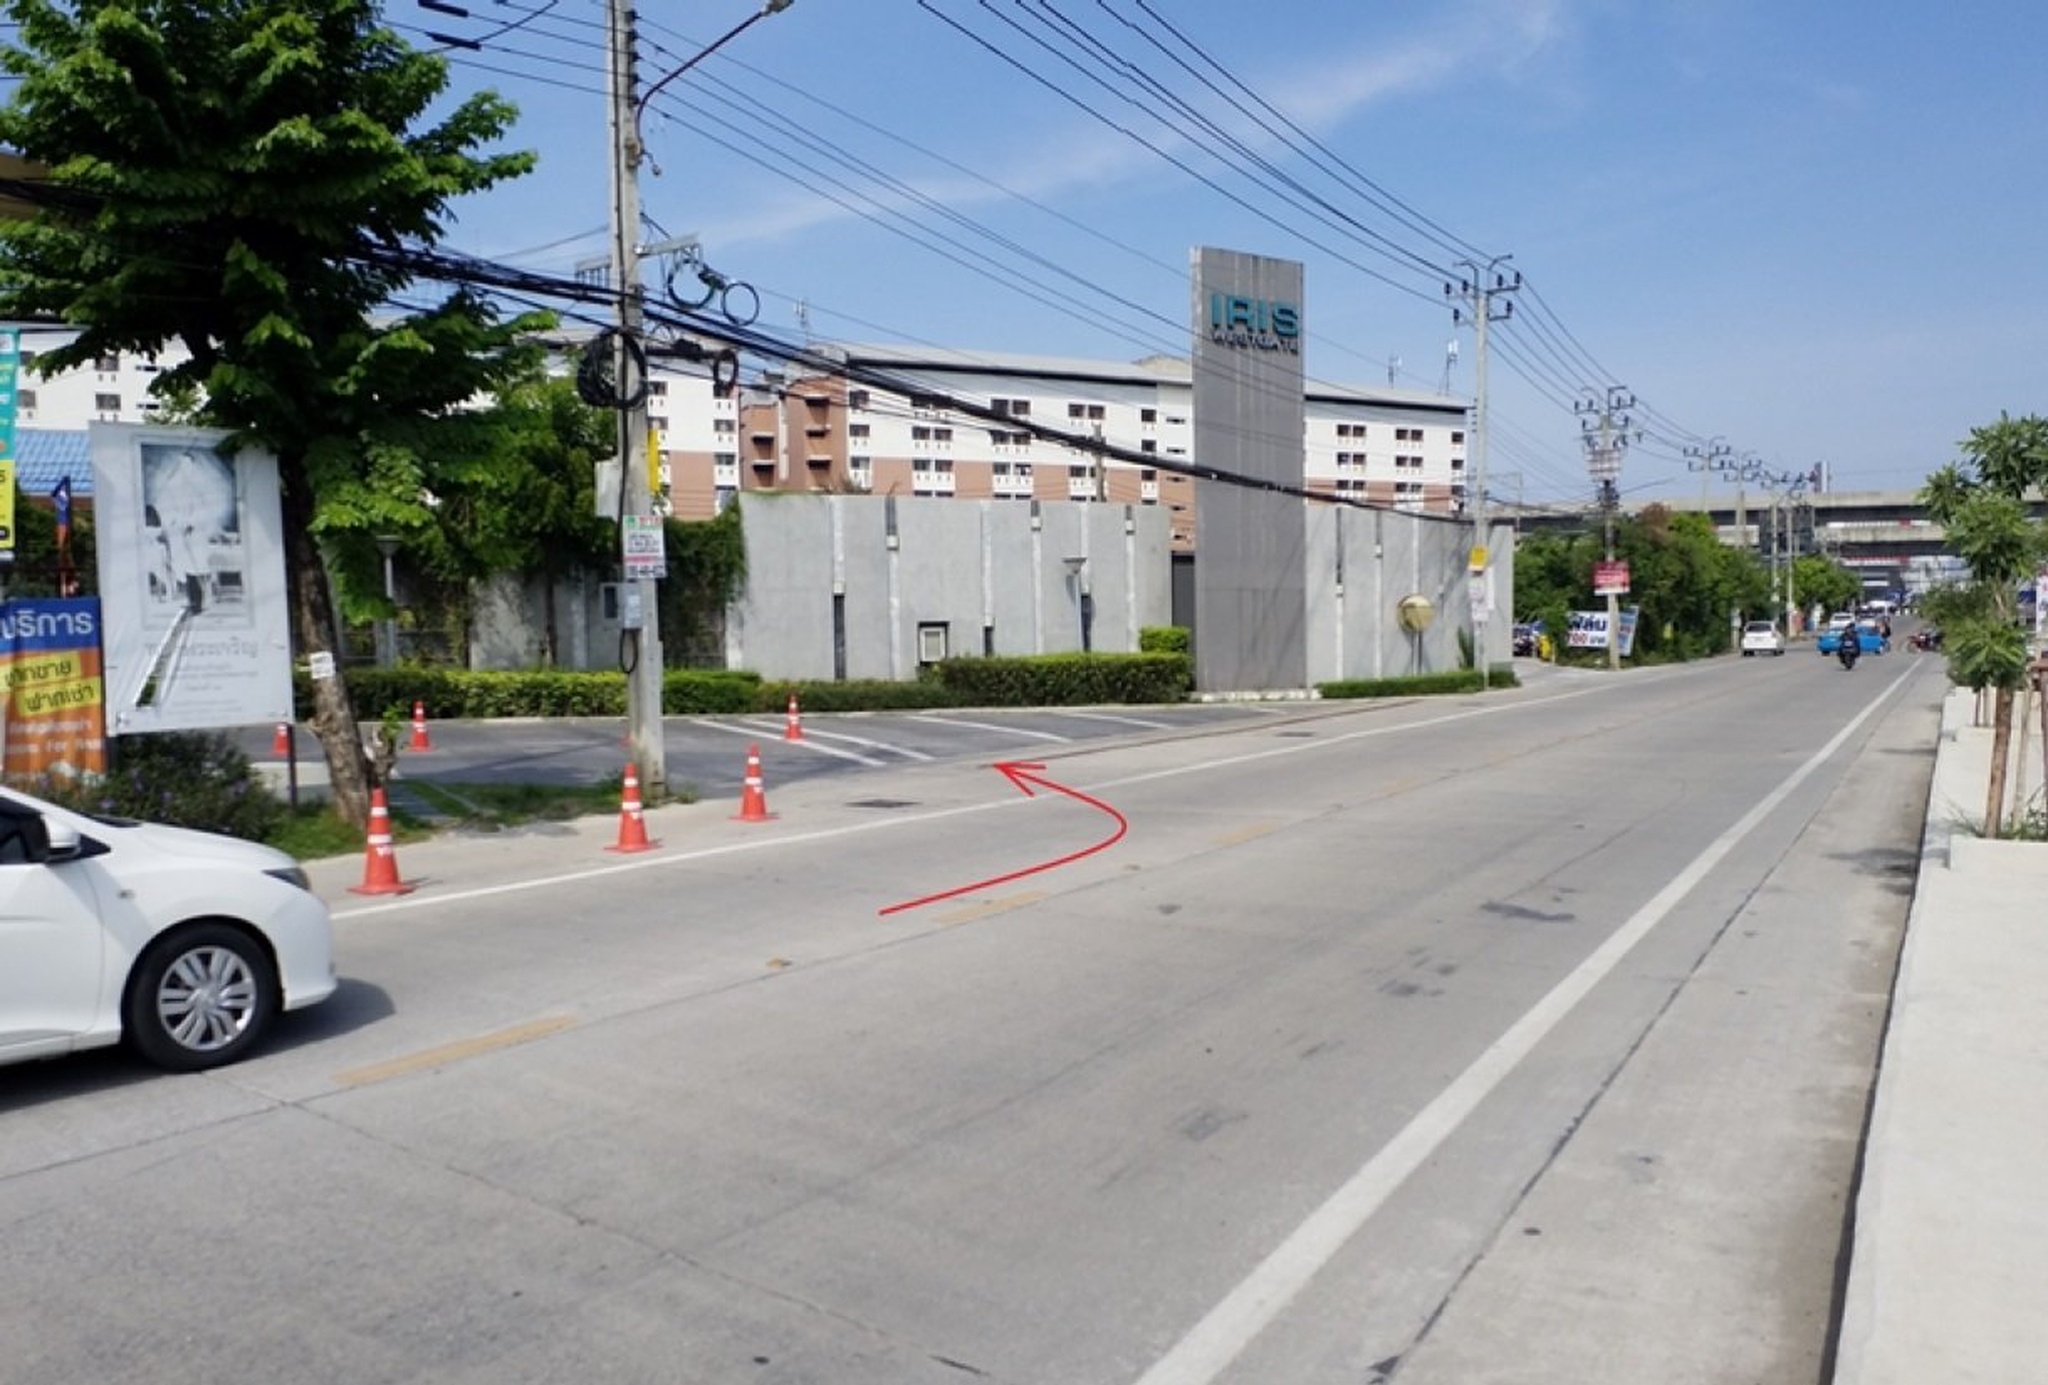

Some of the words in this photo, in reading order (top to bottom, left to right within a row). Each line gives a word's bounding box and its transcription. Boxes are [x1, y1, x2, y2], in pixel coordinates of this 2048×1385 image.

[1210, 293, 1299, 337] IRIS
[2, 608, 94, 639] บริการ
